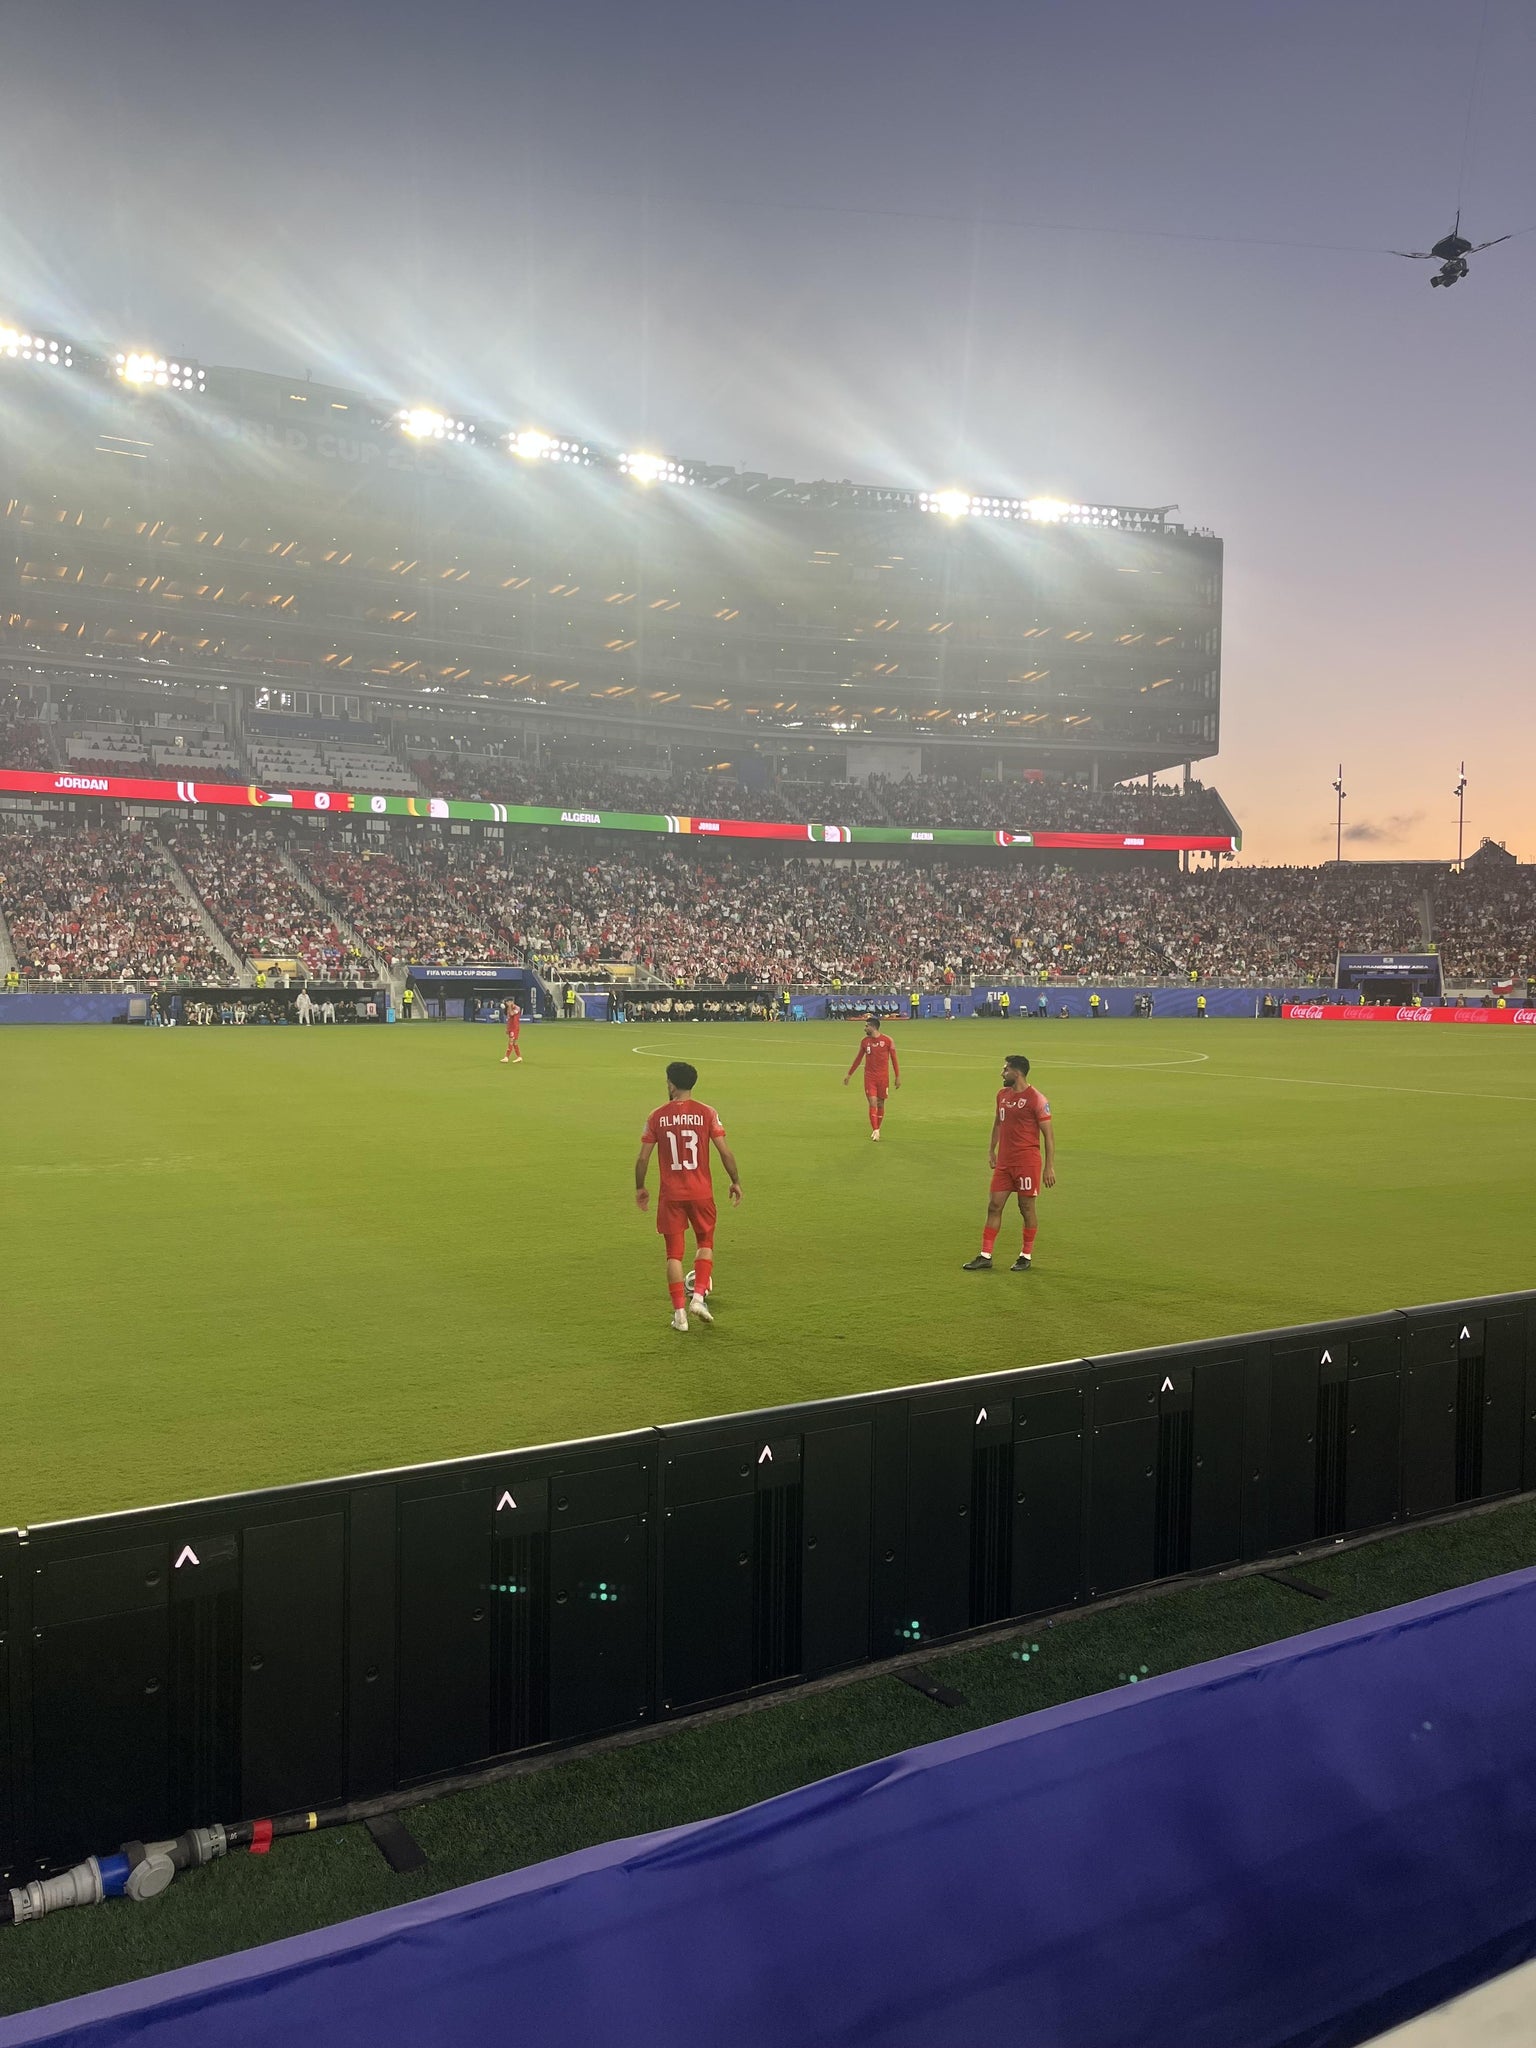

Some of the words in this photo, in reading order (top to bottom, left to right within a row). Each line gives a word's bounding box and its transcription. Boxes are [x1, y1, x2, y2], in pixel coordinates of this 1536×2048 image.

[54, 776, 108, 791] JORDAN
[560, 812, 601, 825] ALGERIA
[988, 991, 1009, 1001] FIF
[659, 1114, 704, 1127] ALMARDI
[666, 1129, 699, 1171] 13
[1019, 1176, 1032, 1191] 10
